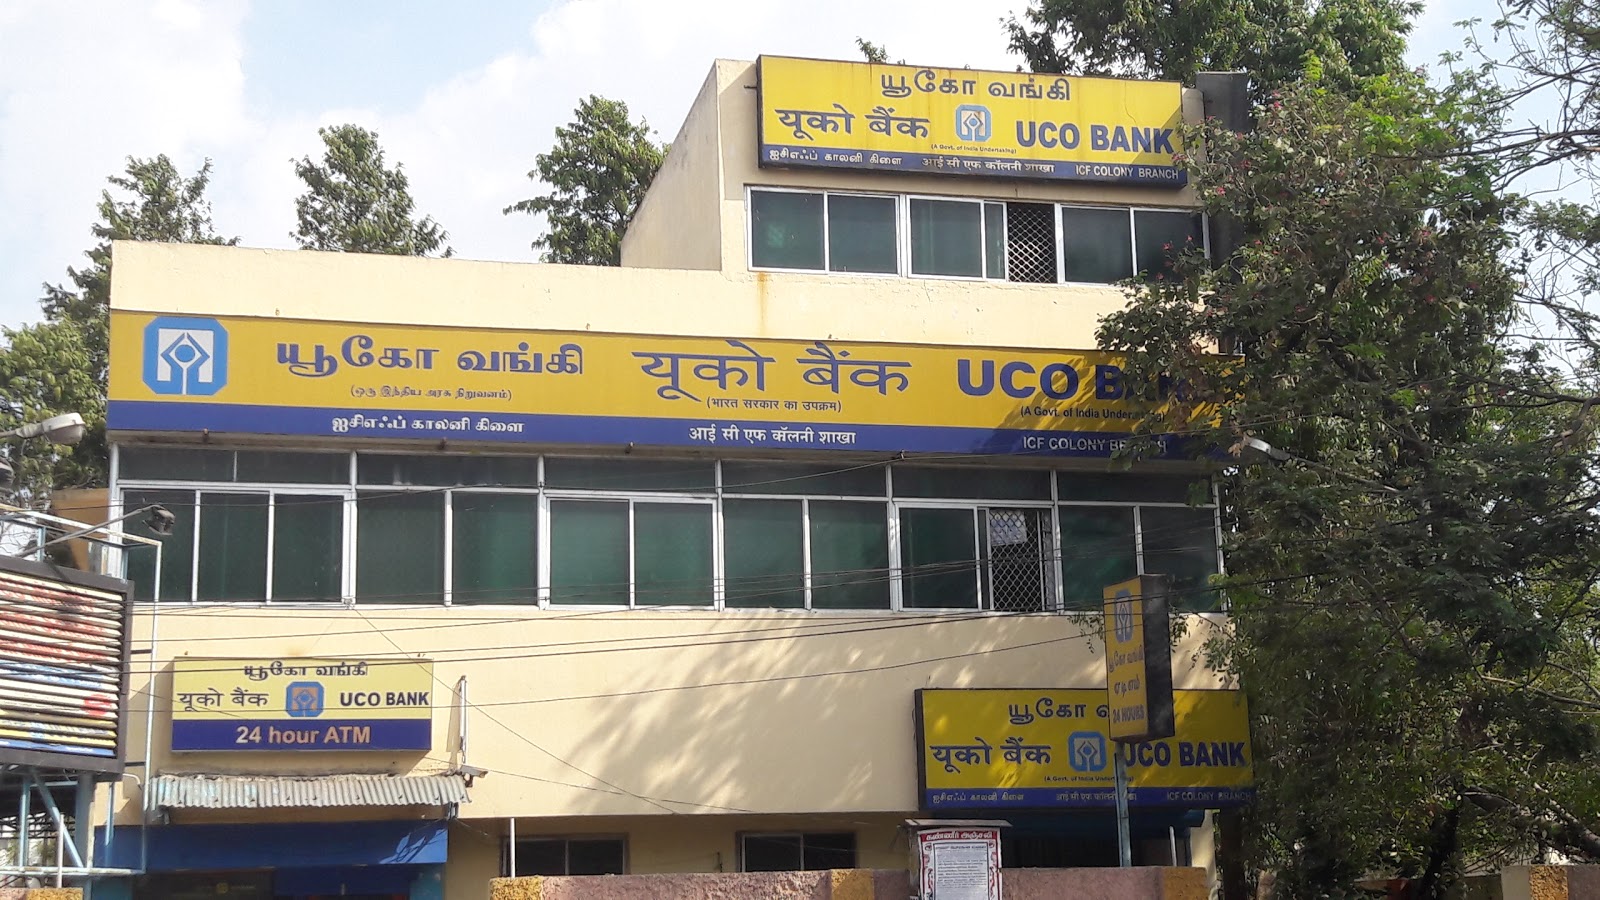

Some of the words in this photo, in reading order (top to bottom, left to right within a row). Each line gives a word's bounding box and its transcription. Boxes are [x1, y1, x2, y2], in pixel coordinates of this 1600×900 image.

[881, 69, 976, 98] யூகோ
[988, 77, 1070, 100] வங்கி
[775, 103, 856, 141] यूको
[864, 106, 931, 139] बैंक
[1016, 120, 1080, 149] UCO
[1090, 124, 1174, 154] BANK
[869, 154, 902, 165] கிளை
[979, 146, 1017, 154] Undertaking)
[922, 156, 944, 169] आई
[946, 157, 960, 168] सी
[963, 160, 981, 171] एफ
[984, 159, 1021, 172] कॉलनी
[1024, 163, 1055, 173] शाखा
[1075, 165, 1091, 176] ICF
[1093, 165, 1133, 177] COLONY
[1138, 167, 1179, 180] BRANCH
[276, 334, 439, 378] யூகோ
[457, 341, 583, 375] வங்கி
[631, 338, 776, 402] यूको
[796, 341, 912, 396] बैंक
[957, 358, 1079, 400] UCO
[380, 385, 422, 398] இந்திய
[455, 387, 512, 401] நிறுவனம்)
[706, 396, 738, 409] (भारत
[743, 399, 779, 410] सरकार
[784, 400, 798, 411] का
[802, 400, 842, 413] उपक्रम)
[1020, 406, 1031, 417] (A
[1034, 406, 1060, 417] Govt.
[1063, 407, 1073, 417] of
[1076, 408, 1099, 418] India
[411, 416, 471, 431] காலனி
[475, 417, 524, 433] கிளை
[689, 424, 716, 443] आई
[721, 424, 739, 440] सी
[743, 428, 766, 443] एफ
[770, 425, 814, 443] कॉलनी
[818, 430, 856, 444] शाखा
[1023, 436, 1045, 449] ICF
[1049, 437, 1106, 451] COLONY
[244, 660, 306, 681] யூகோ
[316, 661, 368, 676] வங்கி
[177, 687, 225, 712] यूको
[230, 686, 269, 707] बैंक
[340, 692, 381, 706] UCO
[386, 691, 430, 706] BANK
[1008, 697, 1086, 725] யூகோ
[1121, 704, 1145, 722] HOURS
[235, 725, 261, 744] 24
[268, 725, 320, 744] hour
[323, 725, 371, 744] ATM
[929, 736, 993, 774] यूको
[1000, 736, 1051, 765] बैंक
[1179, 741, 1247, 767] BANK
[1166, 791, 1179, 800] ICF
[1181, 791, 1213, 800] COLONY
[1218, 791, 1251, 801] BRANCH
